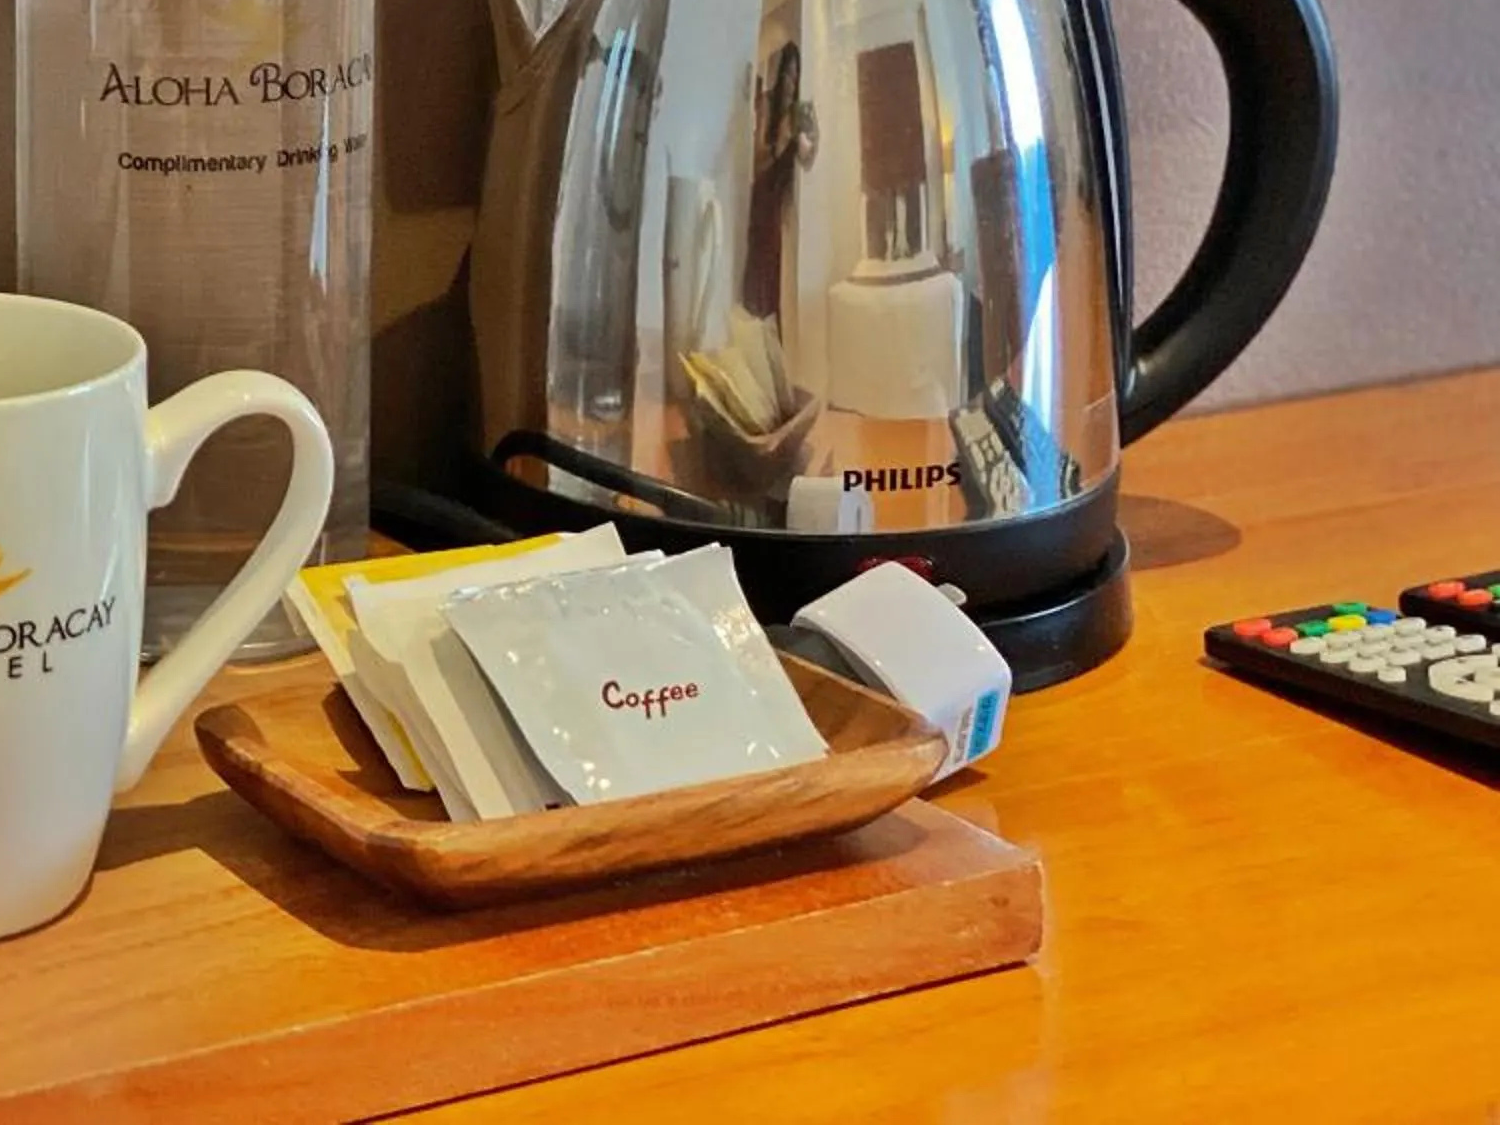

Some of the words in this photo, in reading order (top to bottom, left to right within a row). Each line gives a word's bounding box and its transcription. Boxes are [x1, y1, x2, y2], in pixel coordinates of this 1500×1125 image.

[99, 62, 241, 106] ALOHA
[118, 151, 267, 177] Complimentary
[276, 145, 338, 168] Drinkg
[843, 462, 961, 492] PHILIPS
[602, 679, 700, 720] Coffee
